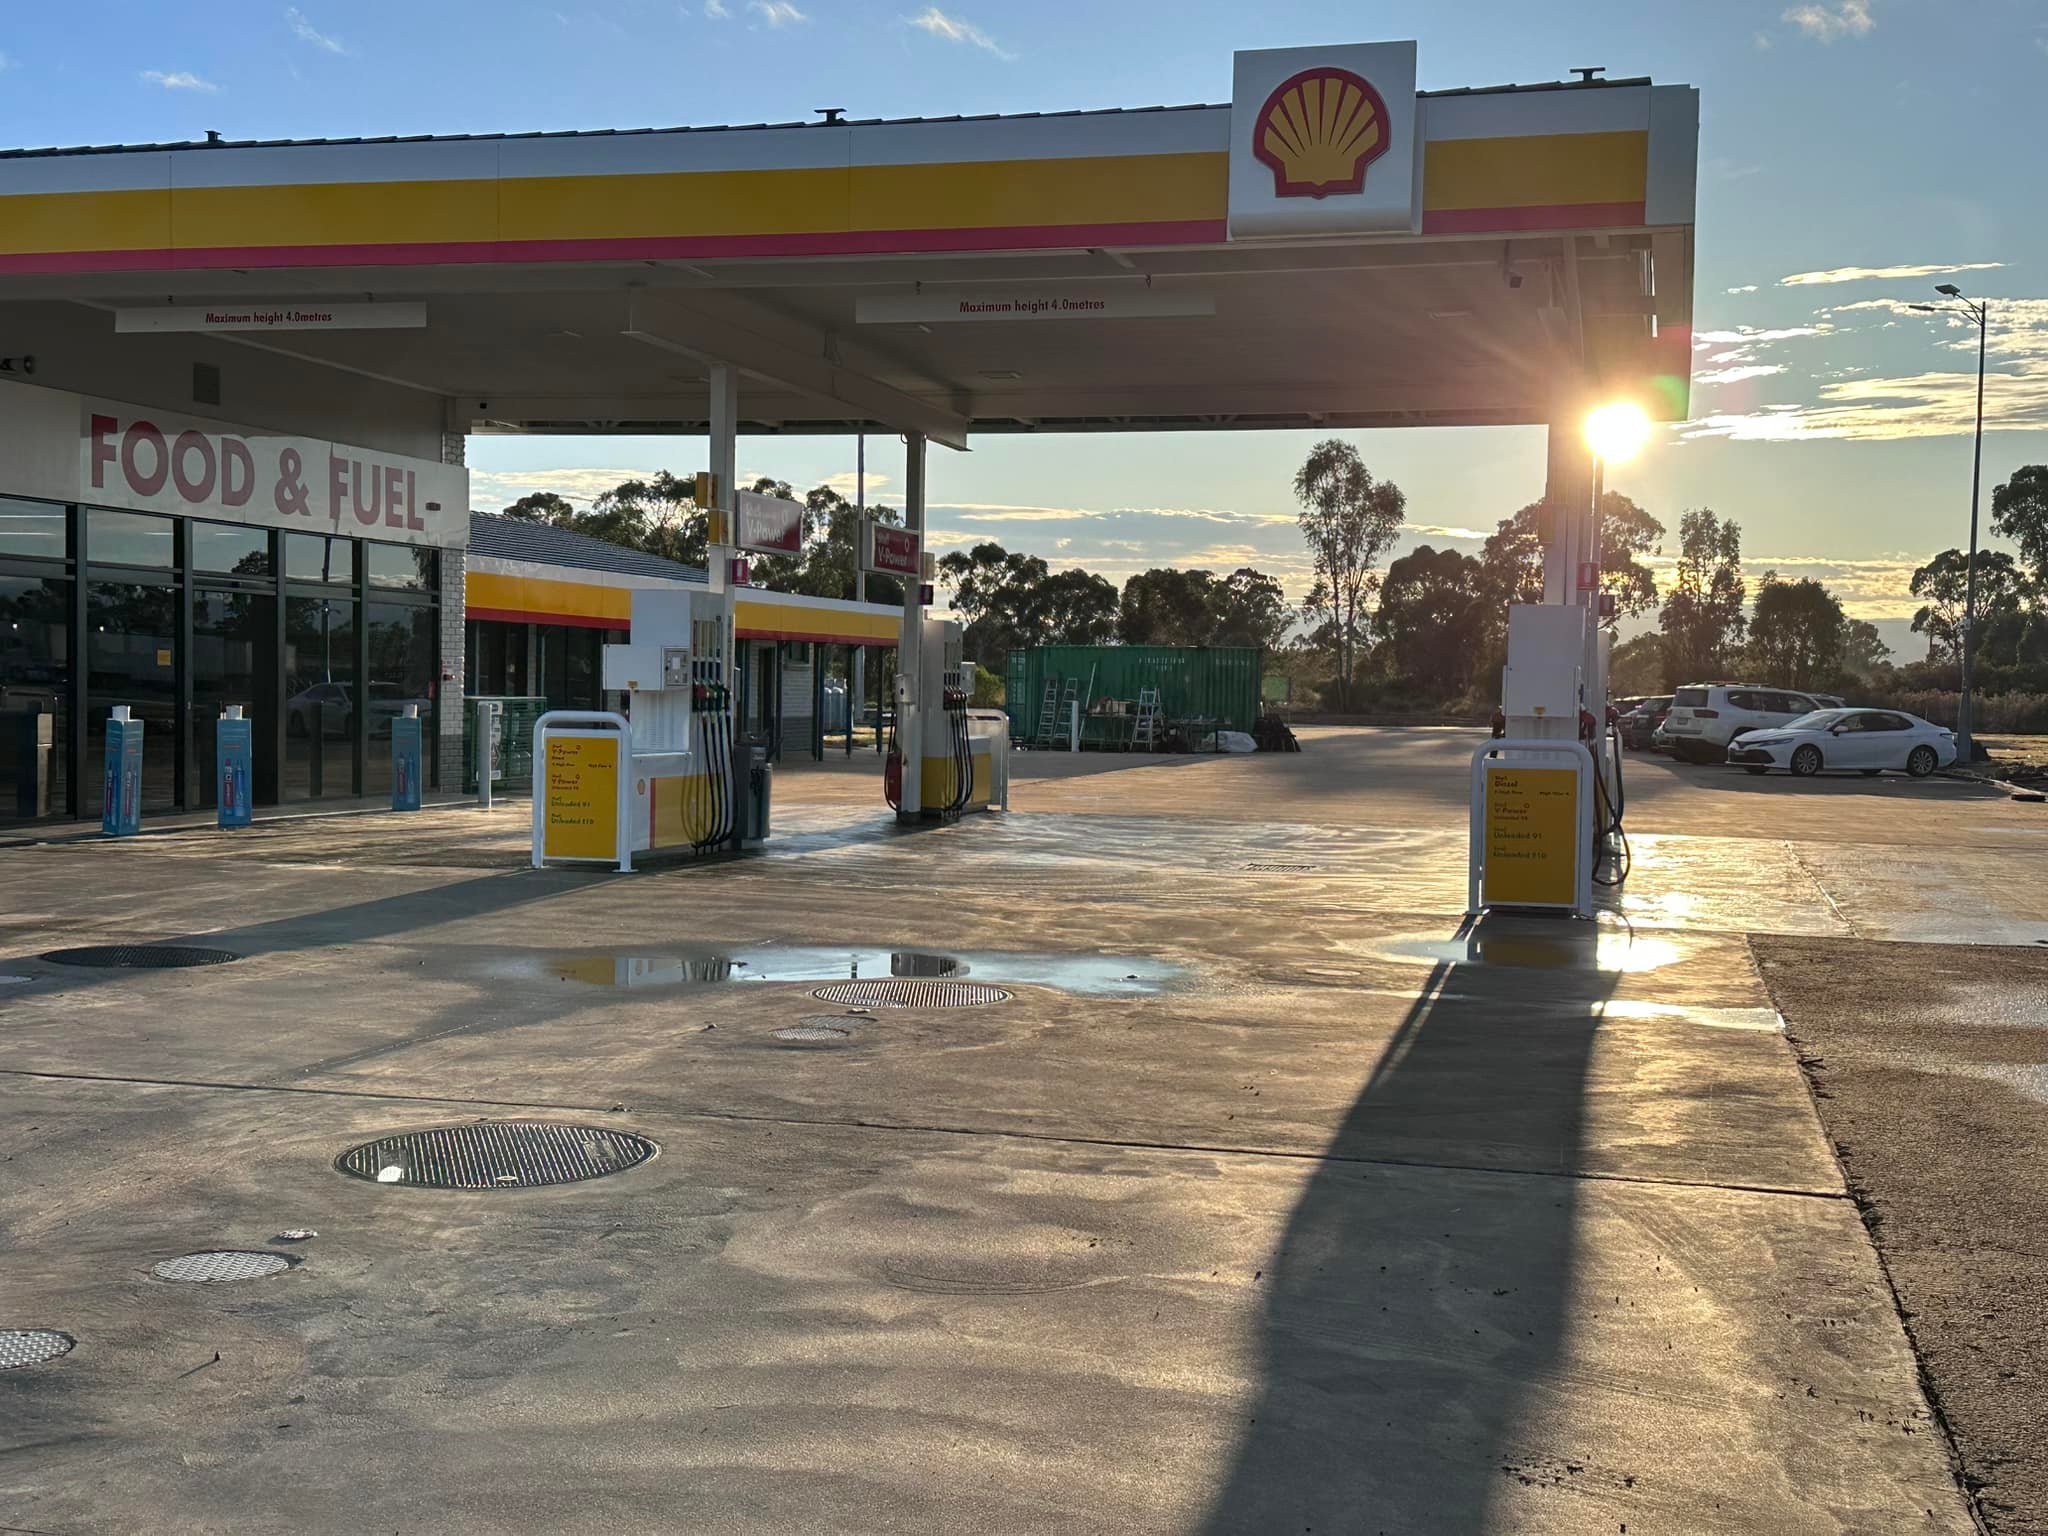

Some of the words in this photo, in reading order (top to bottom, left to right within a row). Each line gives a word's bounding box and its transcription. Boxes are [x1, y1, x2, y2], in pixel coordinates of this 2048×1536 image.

[959, 300, 1011, 313] Maximum
[1014, 299, 1049, 314] height
[1050, 299, 1105, 311] 4.0metres
[206, 311, 251, 324] Maximum
[253, 311, 284, 325] height
[91, 413, 255, 508] FOOD
[274, 447, 312, 517] &
[329, 455, 424, 532] FUEL
